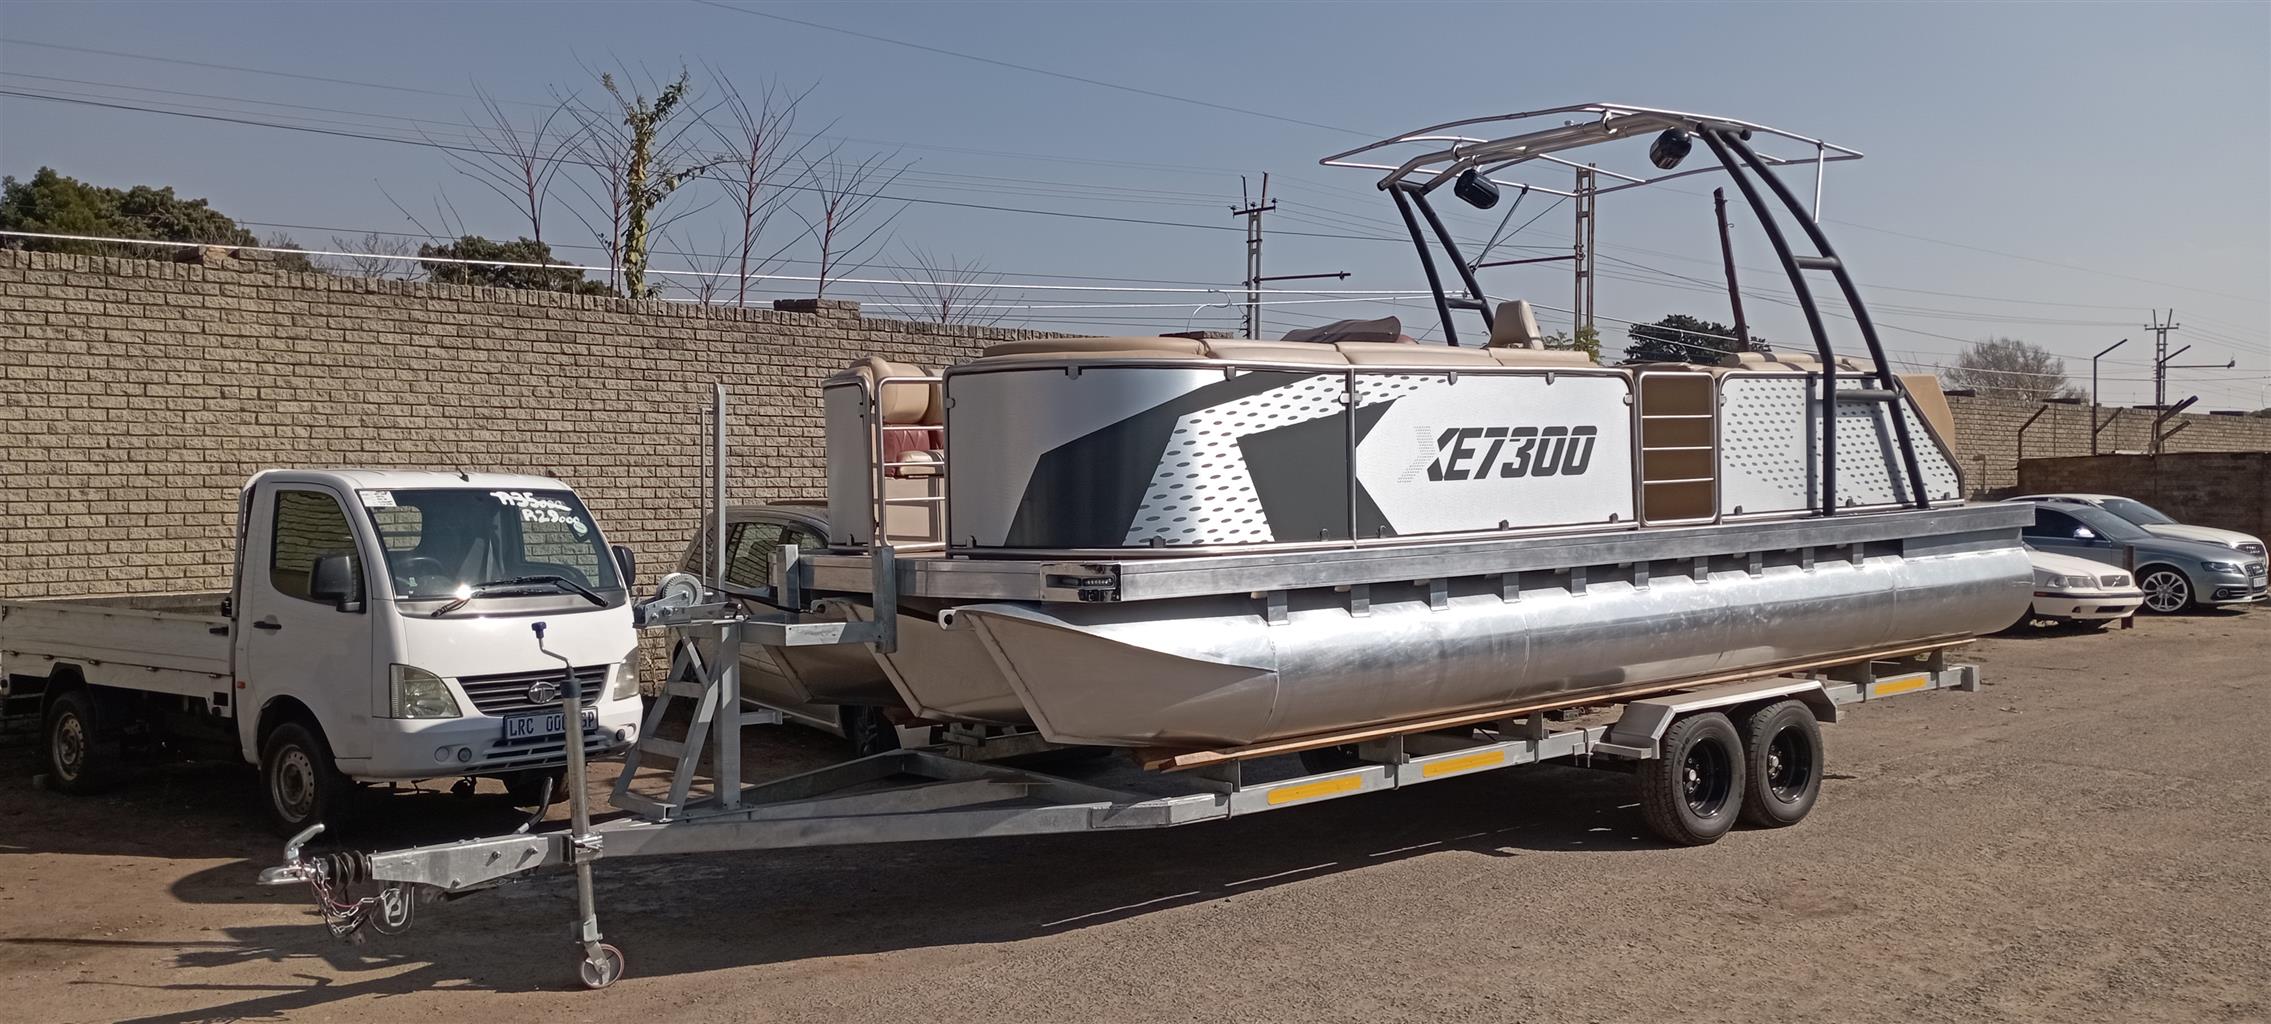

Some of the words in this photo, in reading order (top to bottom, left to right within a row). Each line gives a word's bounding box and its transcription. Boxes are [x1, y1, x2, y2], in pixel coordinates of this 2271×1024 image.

[1398, 425, 1597, 482] XE7300
[521, 508, 580, 524] R29000
[509, 718, 534, 736] LRC
